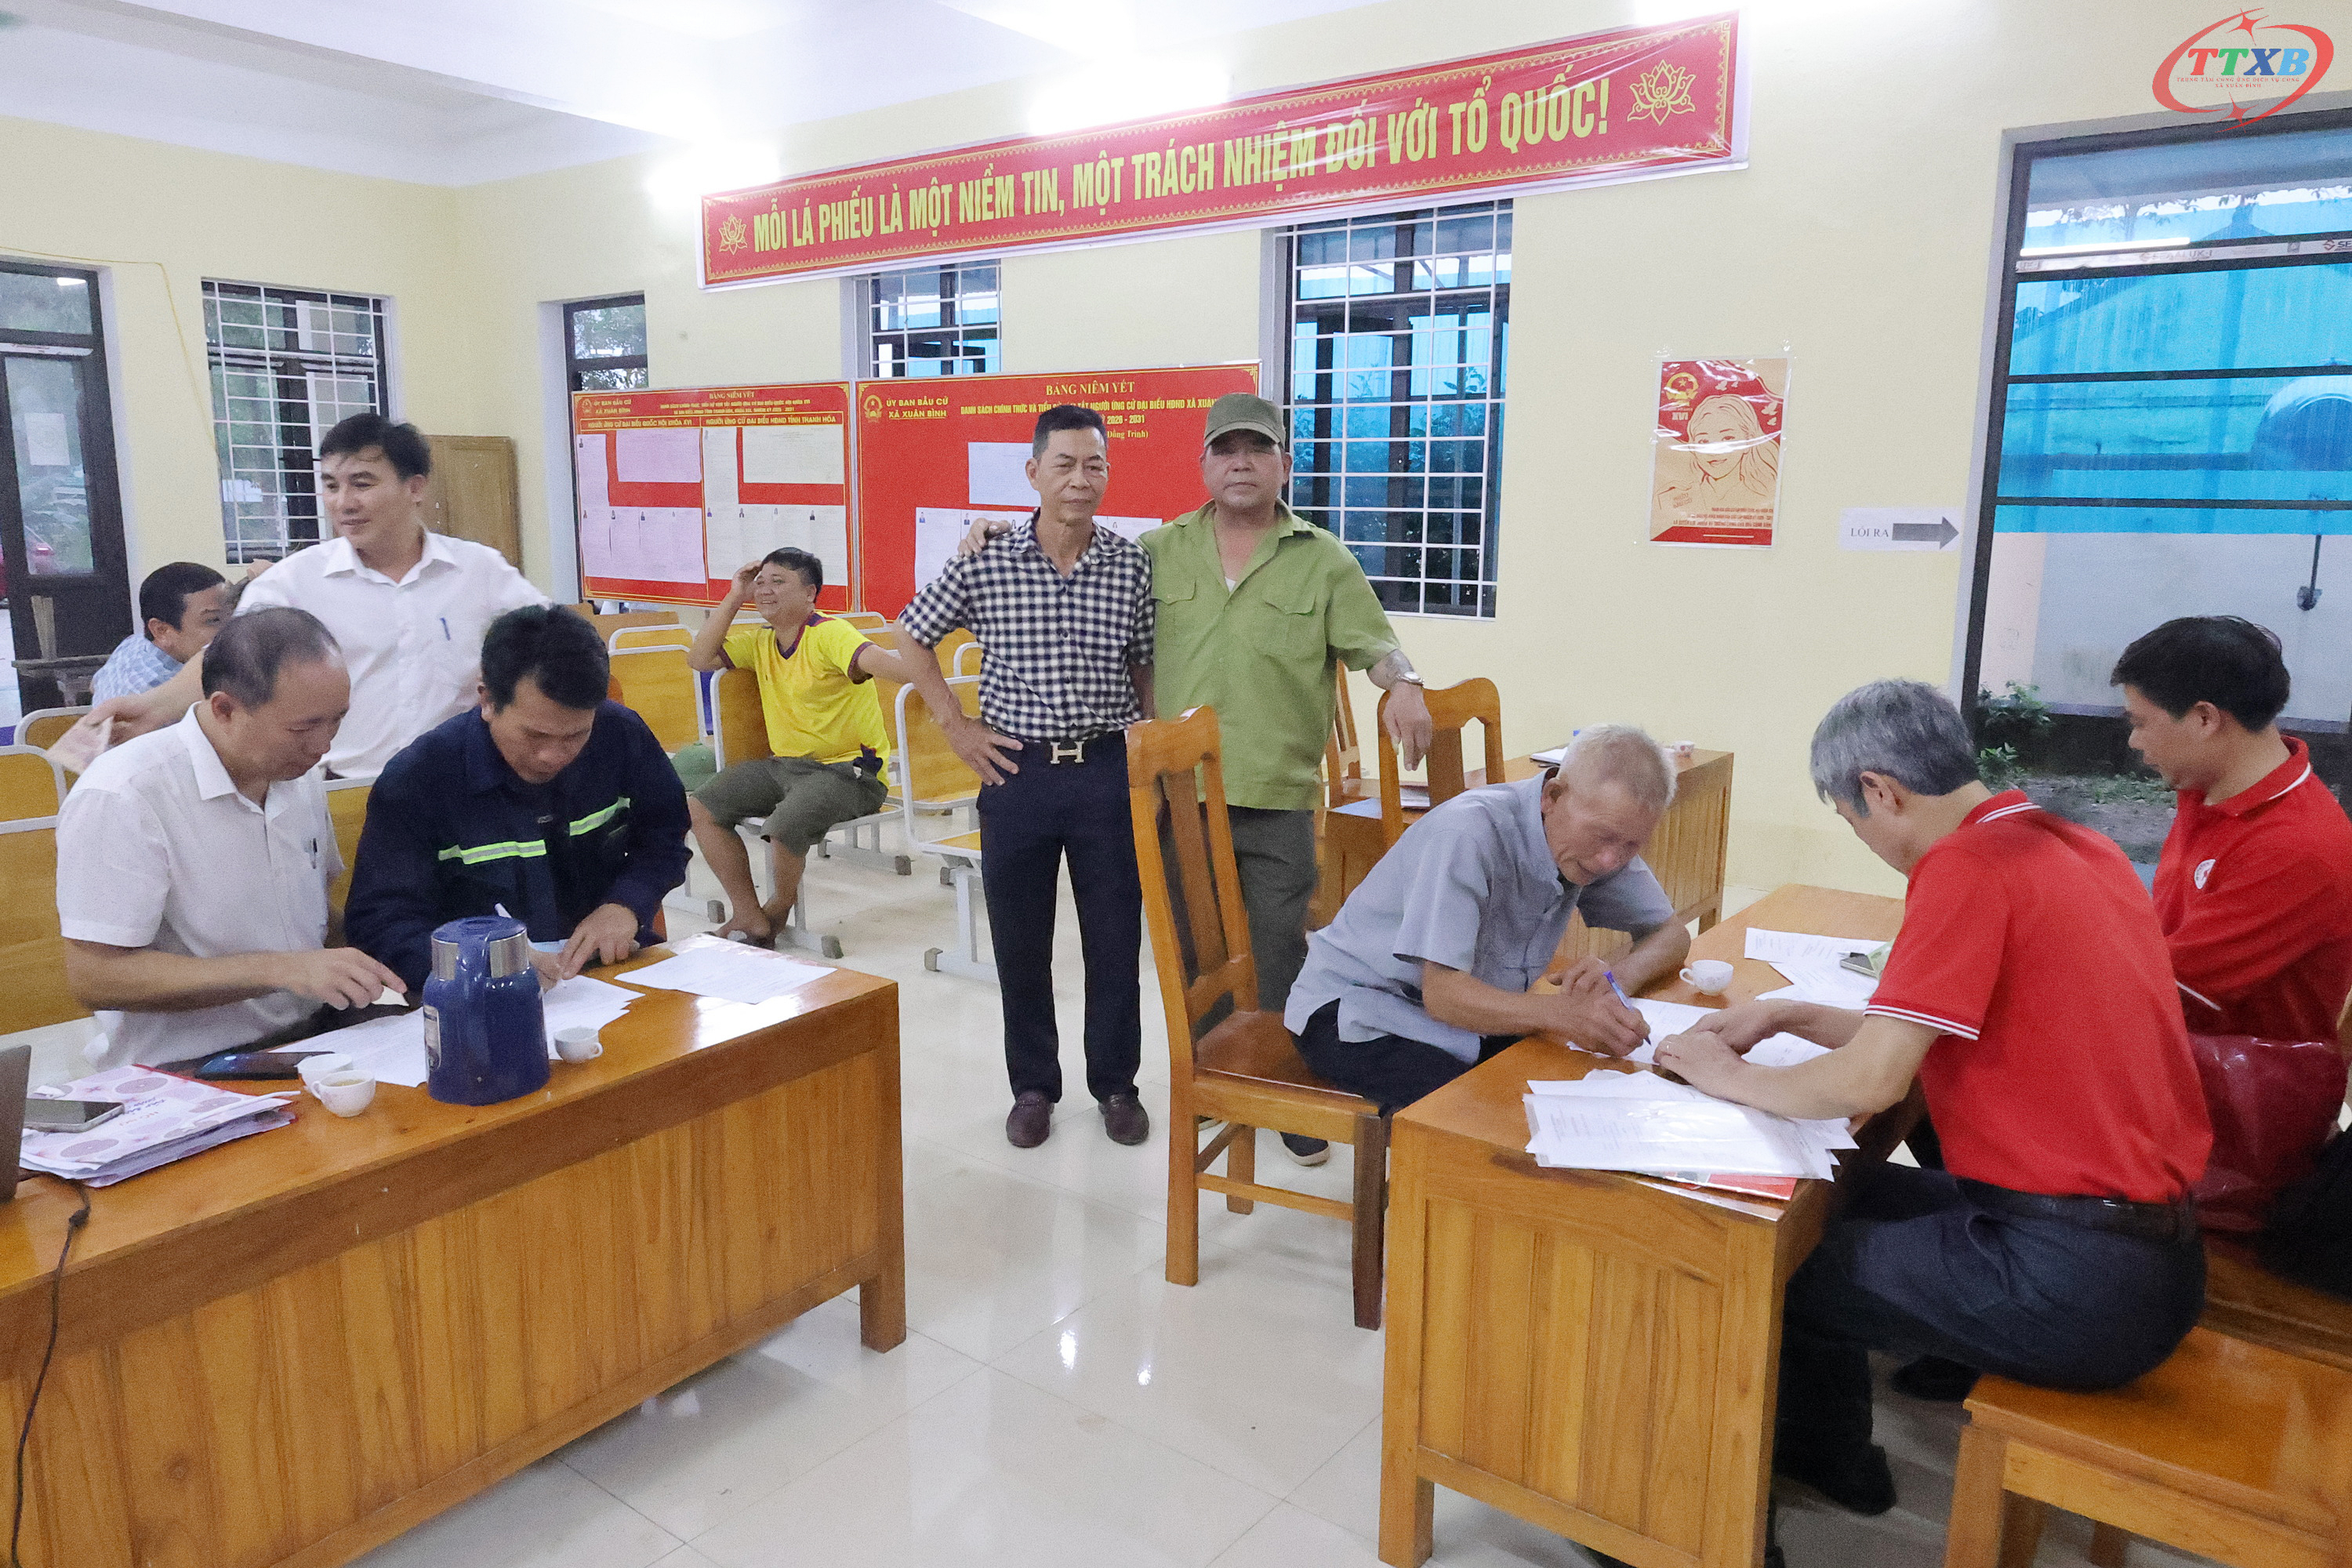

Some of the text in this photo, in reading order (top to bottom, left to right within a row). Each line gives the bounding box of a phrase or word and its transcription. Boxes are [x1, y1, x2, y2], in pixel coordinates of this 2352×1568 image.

[753, 68, 1610, 252] MỖI LÁ PHIẾU LÀ MỘT NIỀM TIN, MỘT TRÁCH NHIỆM ĐỐI VỚI TỔ QUỐC!
[1045, 379, 1135, 396] BẢNG NIÊM YẾT
[927, 408, 947, 417] BÌNH
[1129, 414, 1145, 423] 2031
[1874, 528, 1889, 537] RA
